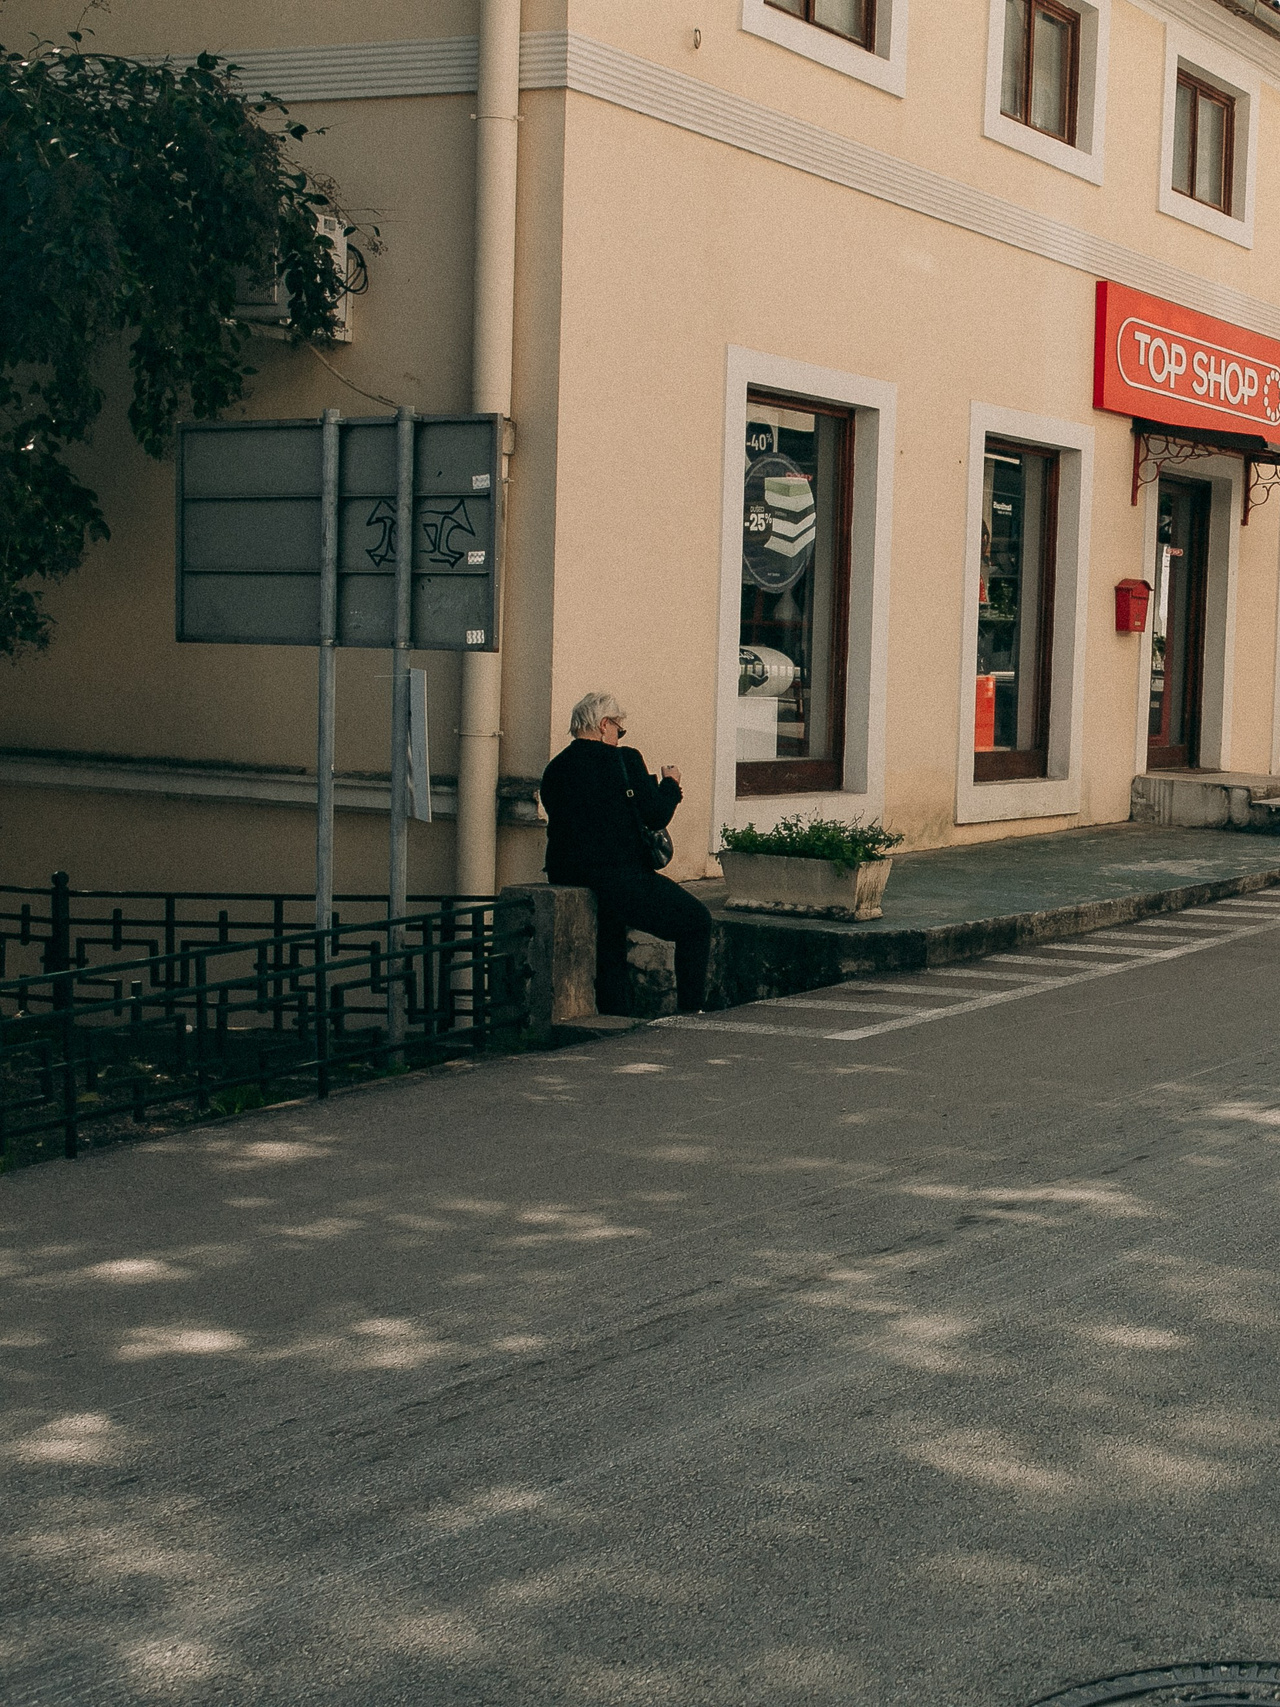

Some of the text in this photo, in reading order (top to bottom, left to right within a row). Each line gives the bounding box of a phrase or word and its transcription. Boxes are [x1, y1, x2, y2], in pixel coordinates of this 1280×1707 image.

[1134, 331, 1258, 405] TOP SHOP
[746, 433, 773, 451] -40%
[744, 513, 772, 531] -25%
